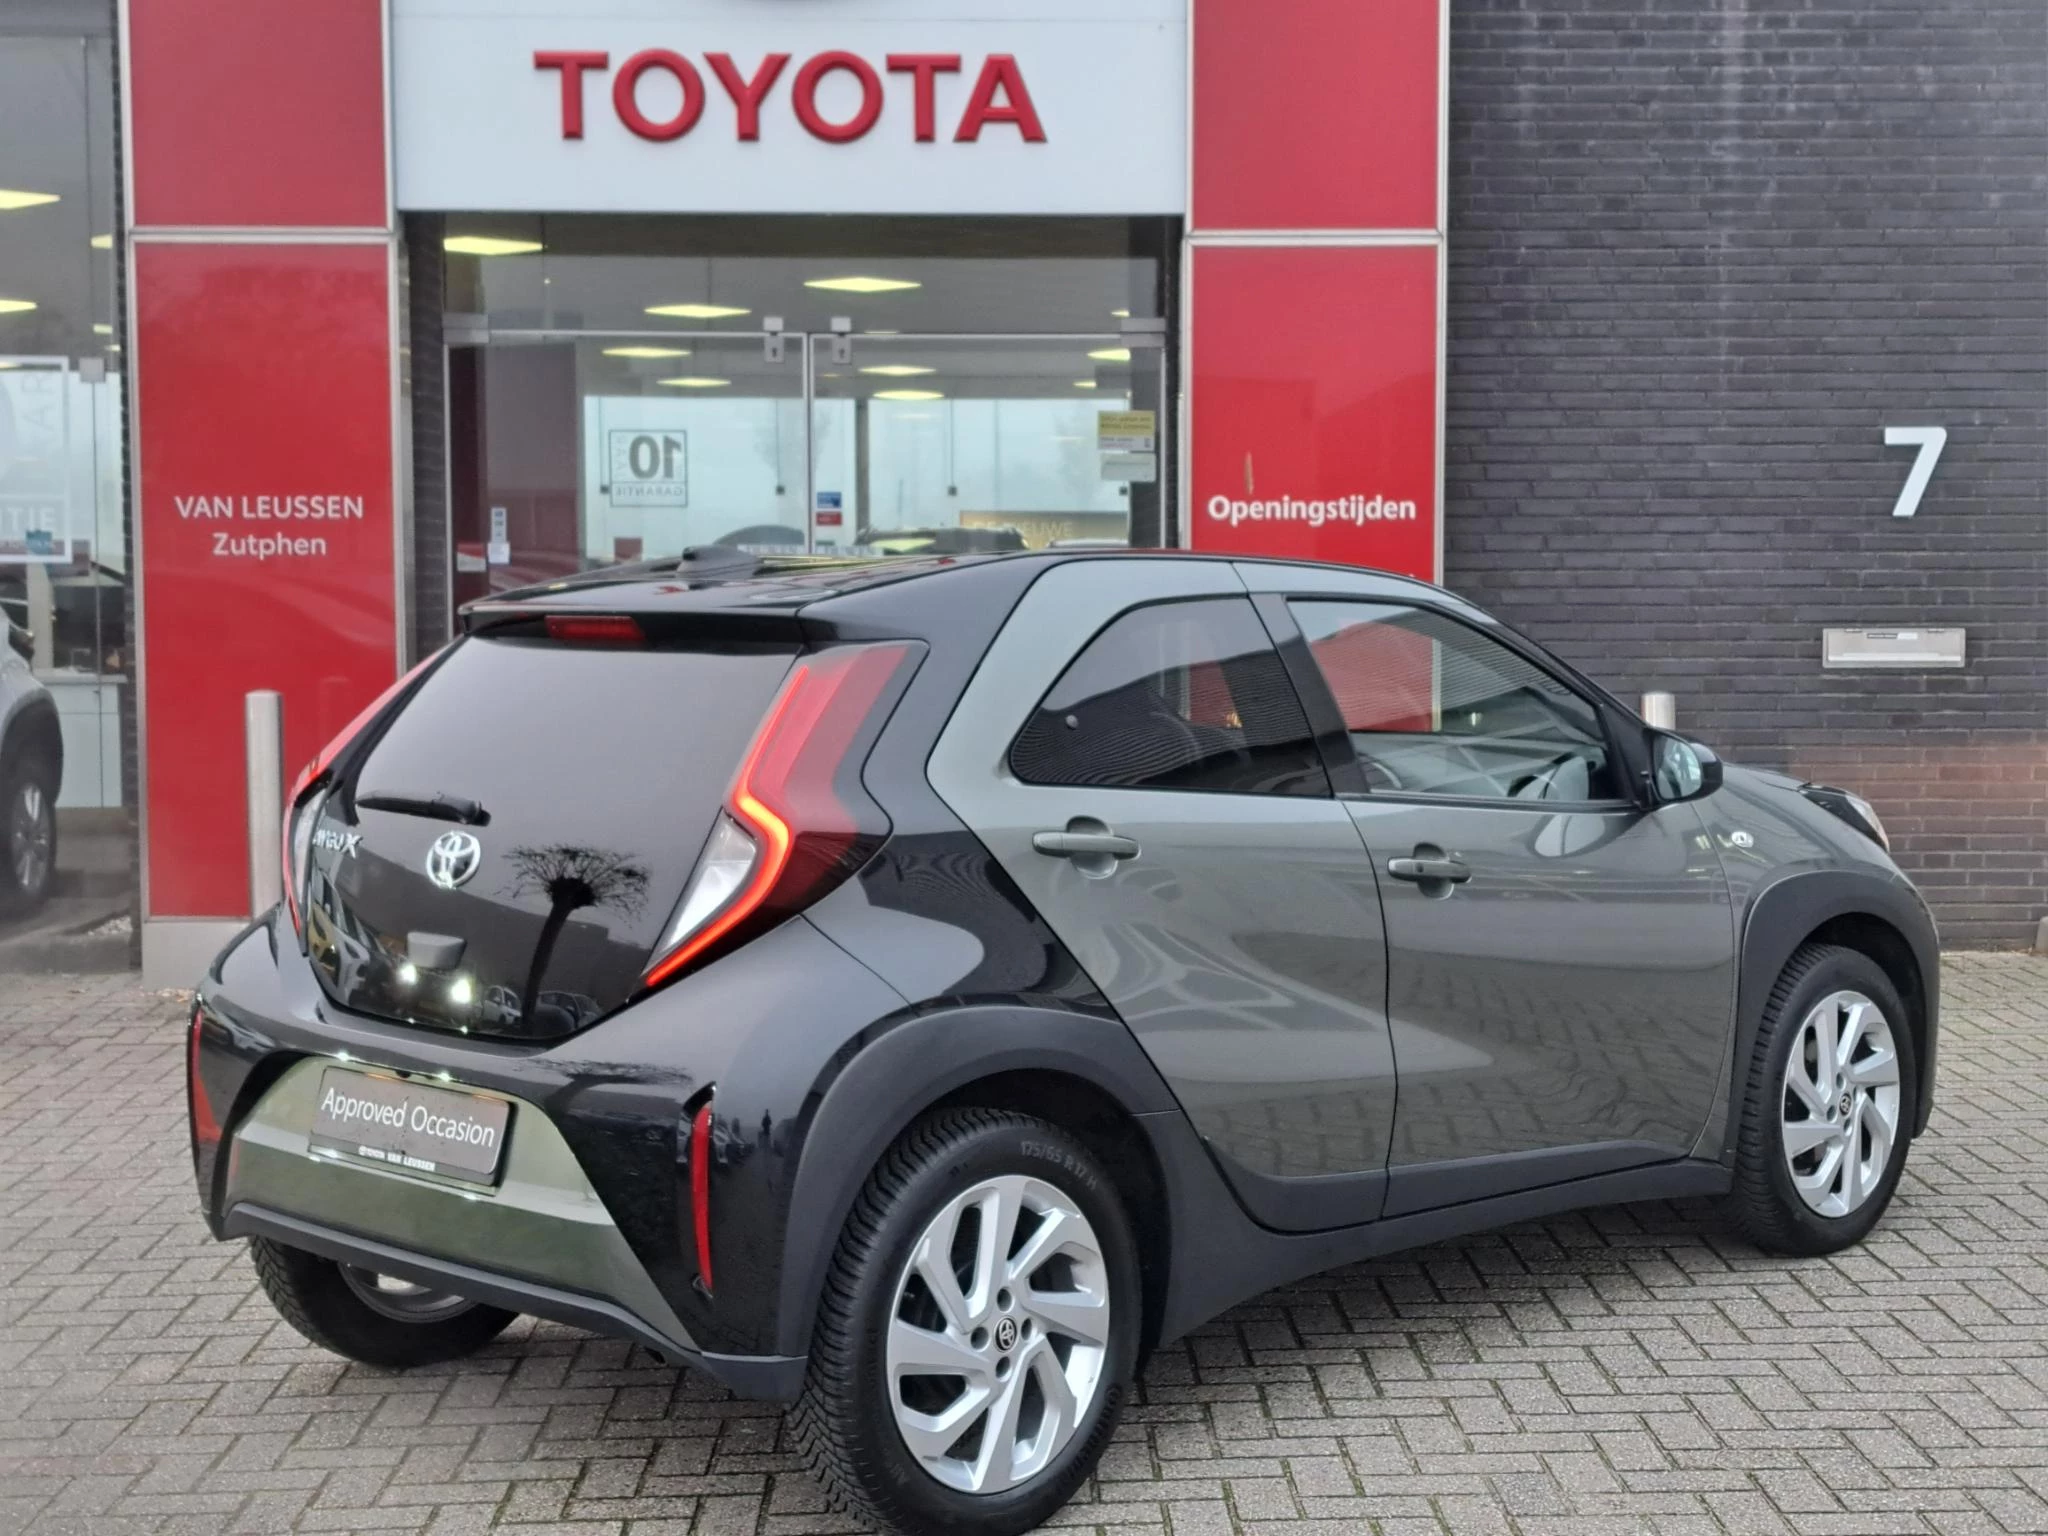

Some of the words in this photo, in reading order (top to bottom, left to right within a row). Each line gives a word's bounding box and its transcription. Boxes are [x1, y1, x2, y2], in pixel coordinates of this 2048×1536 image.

[533, 48, 1048, 144] TOYOTA
[1884, 427, 1947, 517] 7
[174, 495, 233, 519] VAN
[242, 495, 364, 519] LEUSSEN
[1208, 495, 1416, 527] Openingstijden
[212, 532, 327, 560] Zutphen
[321, 1088, 407, 1127] Approved
[411, 1106, 495, 1147] Occasion
[403, 1156, 436, 1171] LEUSSEN
